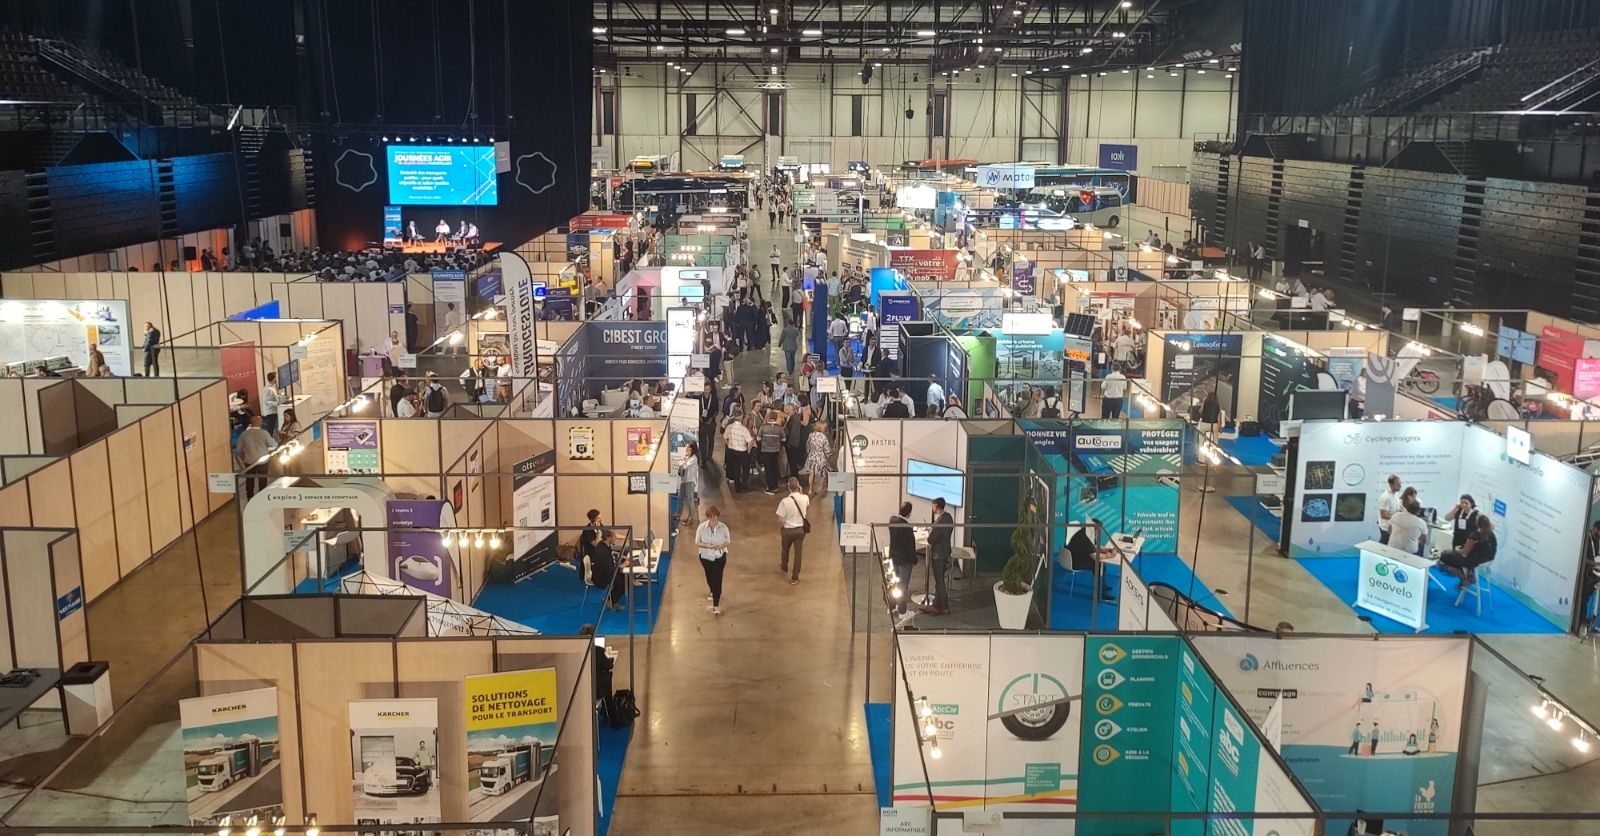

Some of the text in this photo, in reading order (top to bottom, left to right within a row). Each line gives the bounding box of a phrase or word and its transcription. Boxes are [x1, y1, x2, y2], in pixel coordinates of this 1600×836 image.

[603, 329, 642, 344] CIBEST
[1369, 577, 1412, 599] geovelo
[1262, 660, 1320, 671] Affluences
[472, 690, 528, 703] SOLUTIONS
[1012, 694, 1058, 706] START
[212, 704, 246, 713] KÄRCHER
[472, 698, 547, 713] DE NETTOYAGE
[472, 713, 494, 722] POUR
[507, 707, 552, 718] TRANSPORT
